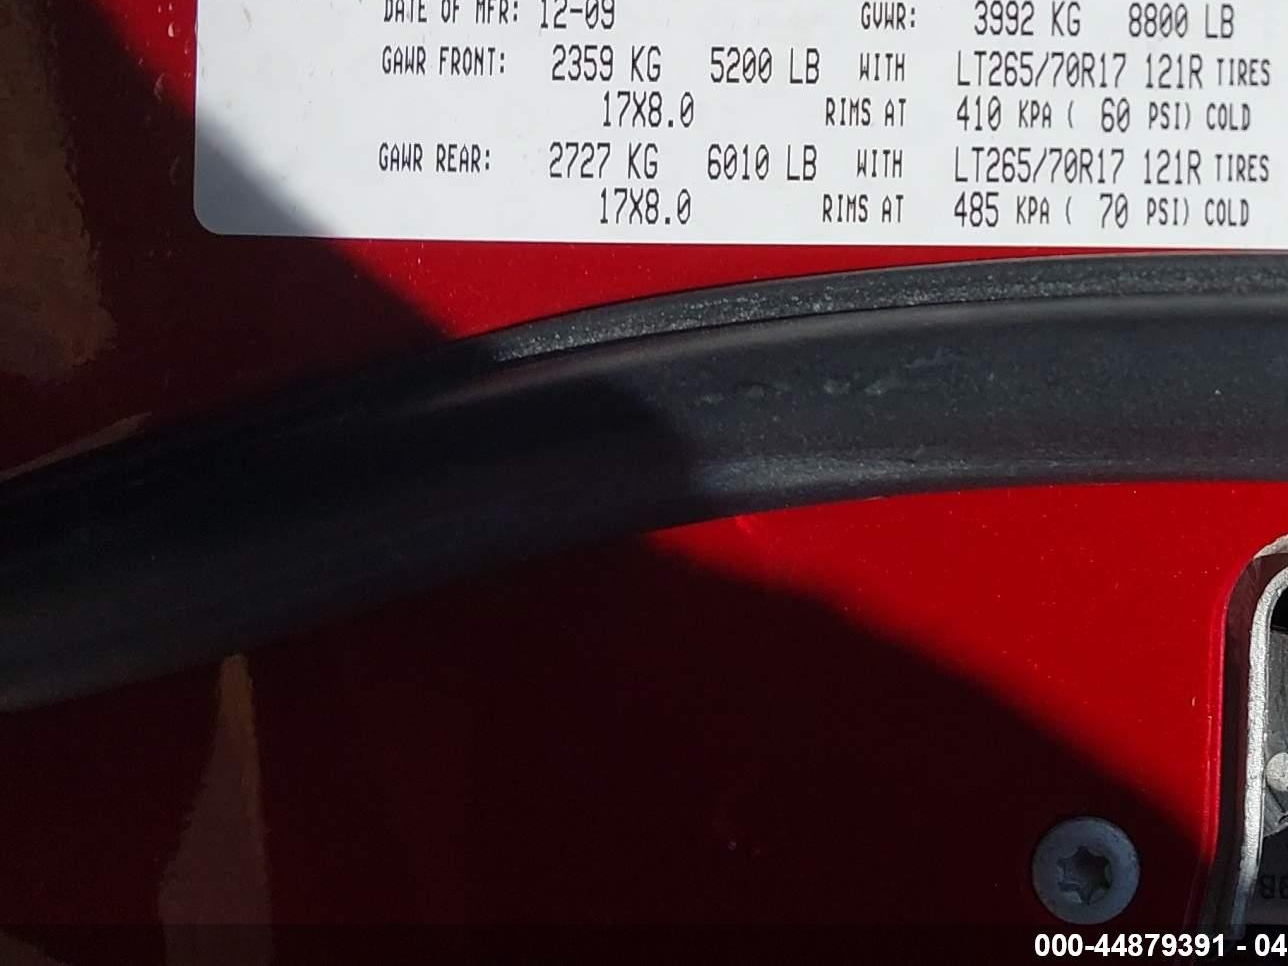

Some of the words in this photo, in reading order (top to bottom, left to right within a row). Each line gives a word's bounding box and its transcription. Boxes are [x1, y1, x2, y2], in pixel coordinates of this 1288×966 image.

[861, 2, 915, 30] GVWR:
[975, 0, 1034, 35] 3992
[1052, 1, 1080, 36] KG
[1129, 3, 1188, 38] 8800
[1206, 4, 1234, 38] LB
[382, 46, 426, 74] GAWR
[439, 47, 504, 75] FRONT:
[552, 45, 613, 81] 2359
[631, 46, 661, 82] KG
[711, 47, 772, 83] 5200
[790, 48, 819, 84] LB
[860, 53, 905, 81] WITH
[958, 51, 1126, 88] LT265/70R17
[1146, 54, 1202, 89] 121R
[1217, 58, 1270, 86] TIRES
[603, 91, 694, 128] 17X8.0
[826, 98, 871, 126] RIMS
[885, 98, 906, 126] AT
[957, 96, 1001, 131] 410
[1019, 100, 1051, 128] KPA
[1101, 97, 1130, 133] 60
[1149, 102, 1190, 130] PSI)
[1207, 103, 1250, 130] COLD
[379, 143, 422, 171] GAWR
[436, 144, 489, 172] REAR:
[550, 142, 610, 178] 2727
[628, 143, 658, 179] KG
[708, 144, 769, 180] 6010
[787, 145, 817, 181] LB
[857, 149, 902, 178] WITH
[955, 146, 1124, 183] LT265/70R17
[1144, 149, 1201, 184] 121R
[1216, 154, 1269, 182] TIRES
[600, 188, 691, 224] 17X8.0
[823, 194, 868, 222] RIMS
[882, 195, 903, 222] AT
[954, 192, 999, 227] 485
[1017, 196, 1049, 224] KPA
[1100, 193, 1128, 228] 70
[1147, 198, 1188, 225] PSI)
[1205, 198, 1248, 226] COLD
